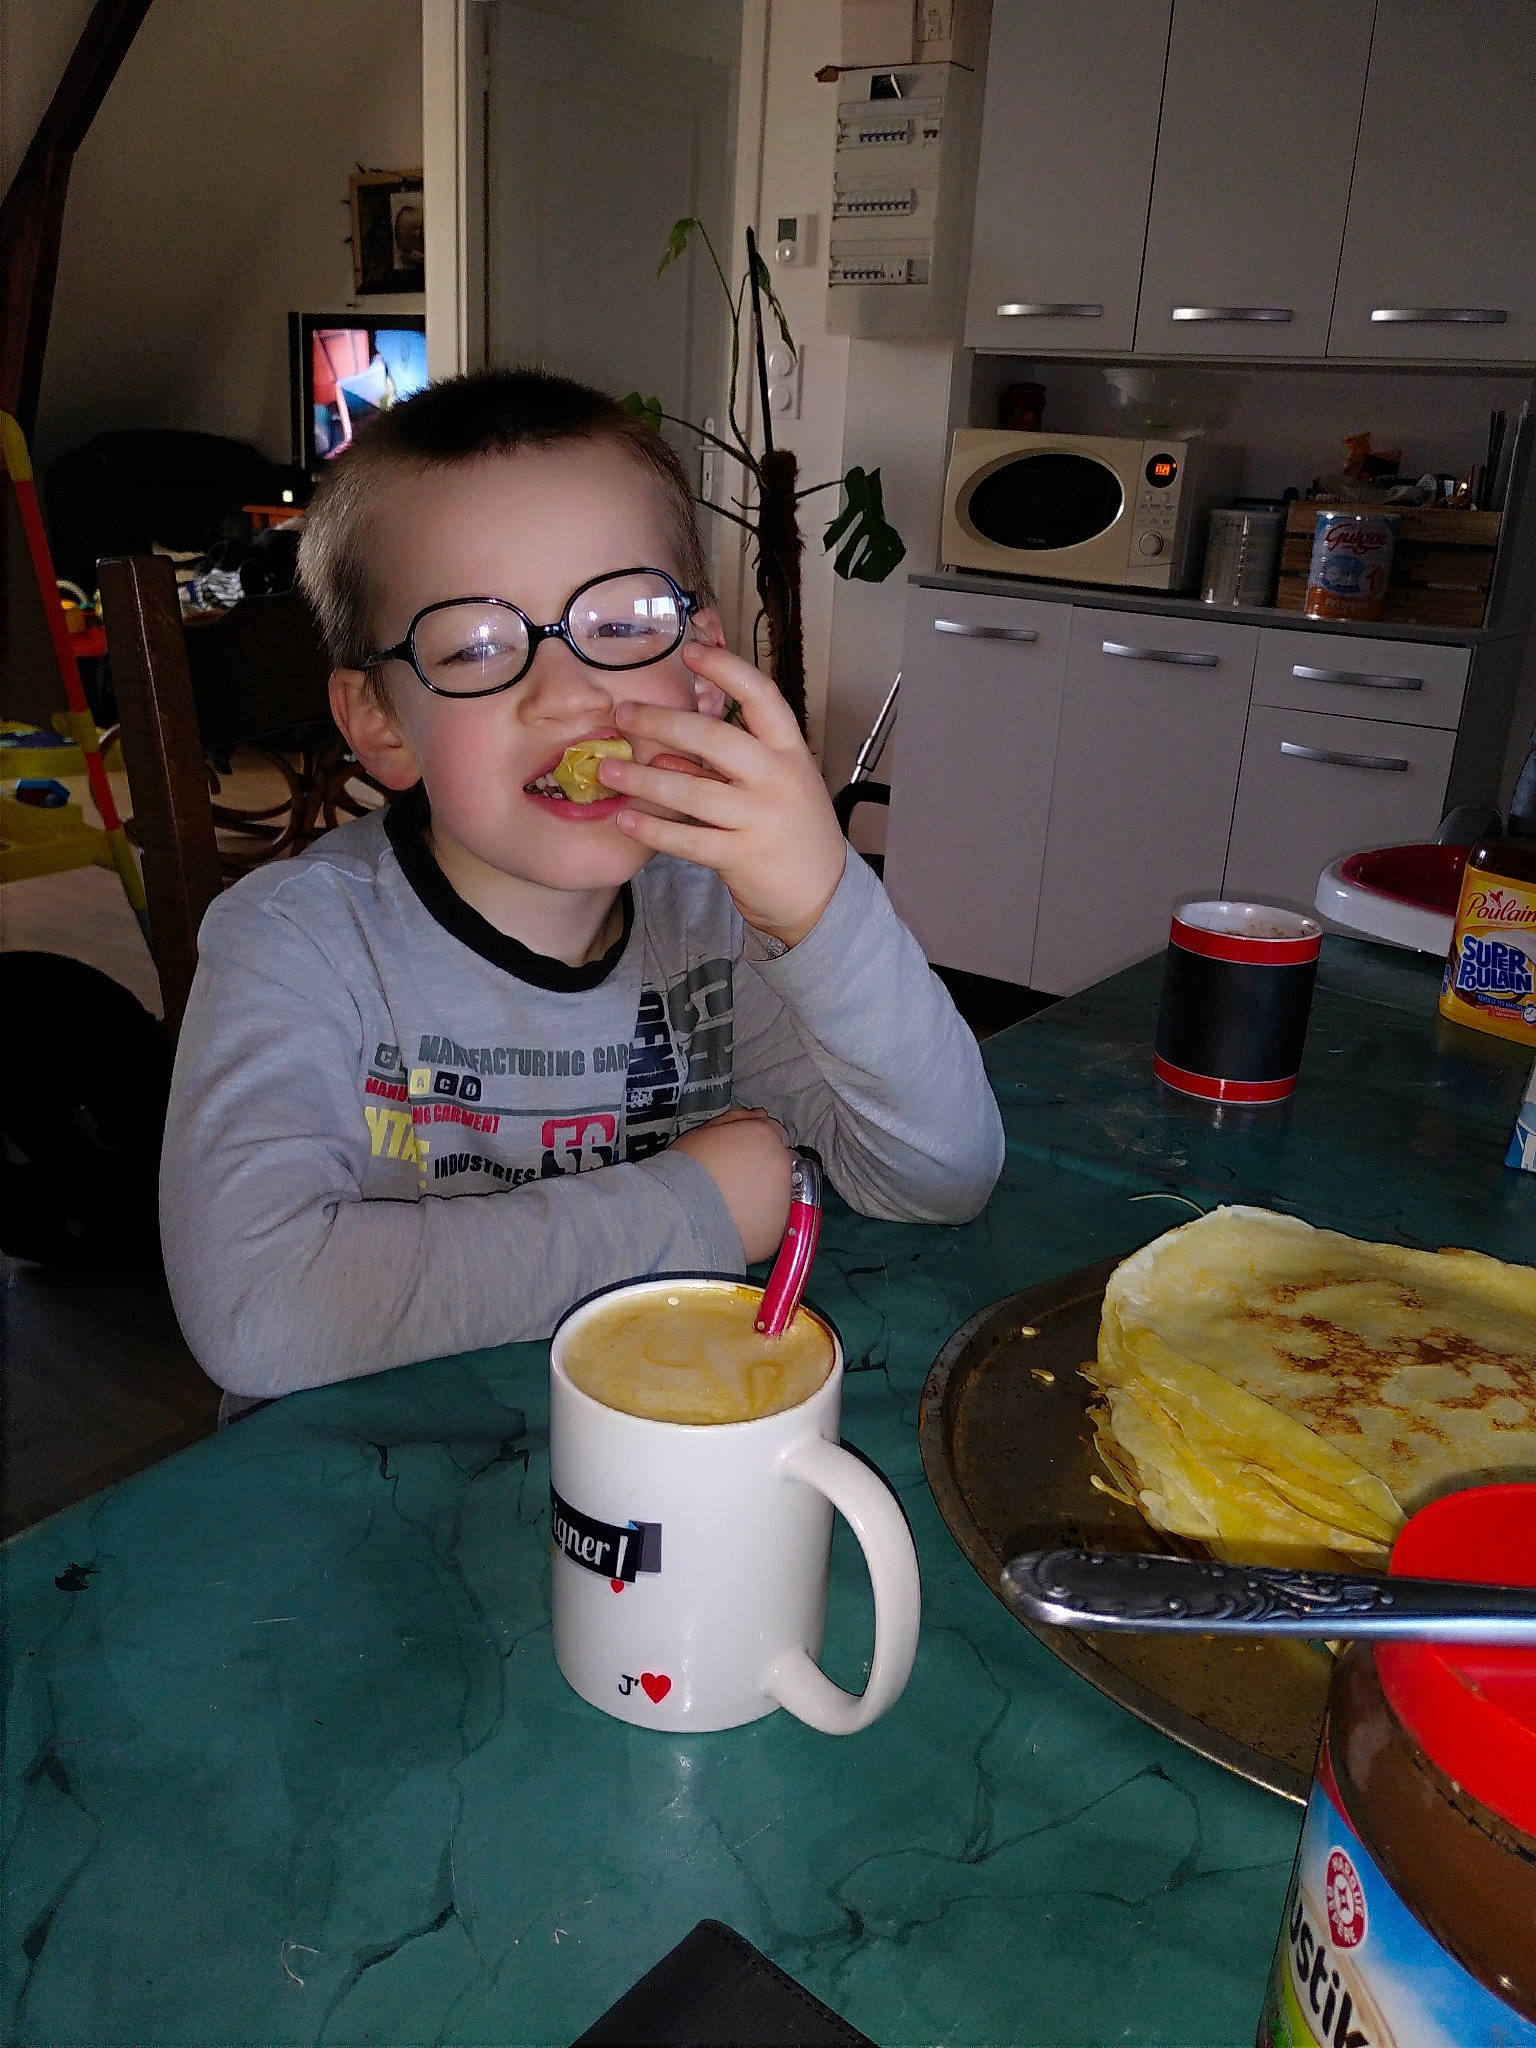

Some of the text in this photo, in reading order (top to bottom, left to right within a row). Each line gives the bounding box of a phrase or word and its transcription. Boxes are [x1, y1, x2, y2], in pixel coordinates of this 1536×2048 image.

[1462, 936, 1529, 974] SUPER
[1458, 959, 1532, 992] POULAIN
[417, 1034, 633, 1077] MANFACTURING GAR
[434, 1104, 500, 1134] GARMENT
[434, 1153, 537, 1186] INDUSTRIES
